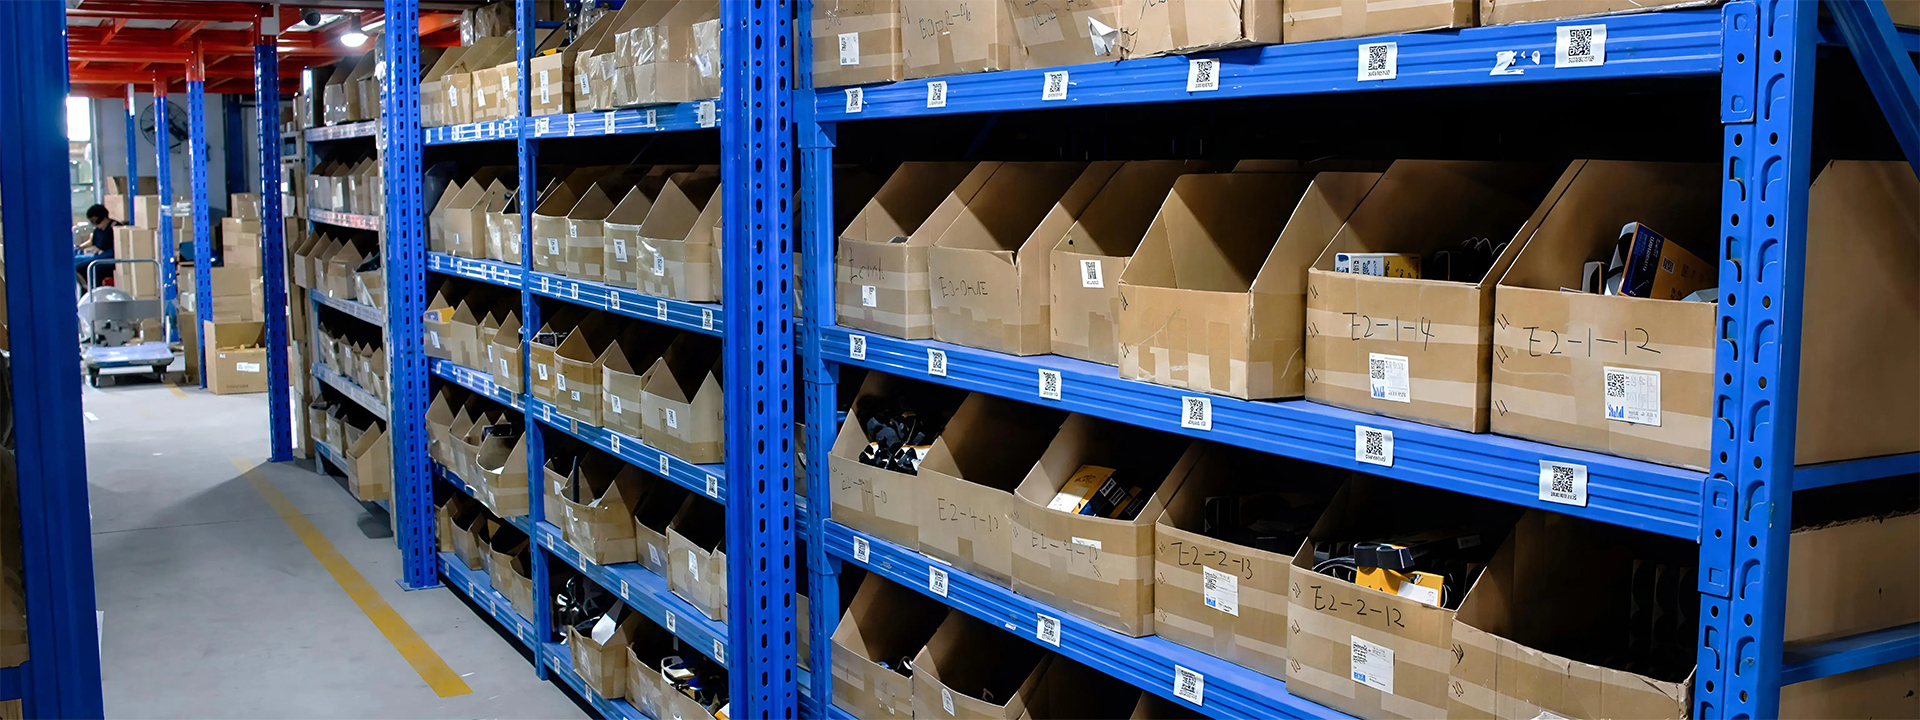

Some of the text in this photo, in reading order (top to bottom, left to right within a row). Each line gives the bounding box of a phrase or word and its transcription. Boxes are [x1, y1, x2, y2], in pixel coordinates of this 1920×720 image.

[1342, 311, 1435, 352] E2-1-14
[1522, 326, 1662, 358] E2-1-12
[1170, 541, 1253, 580] E2-2-13
[1310, 585, 1405, 628] E2-2-12
